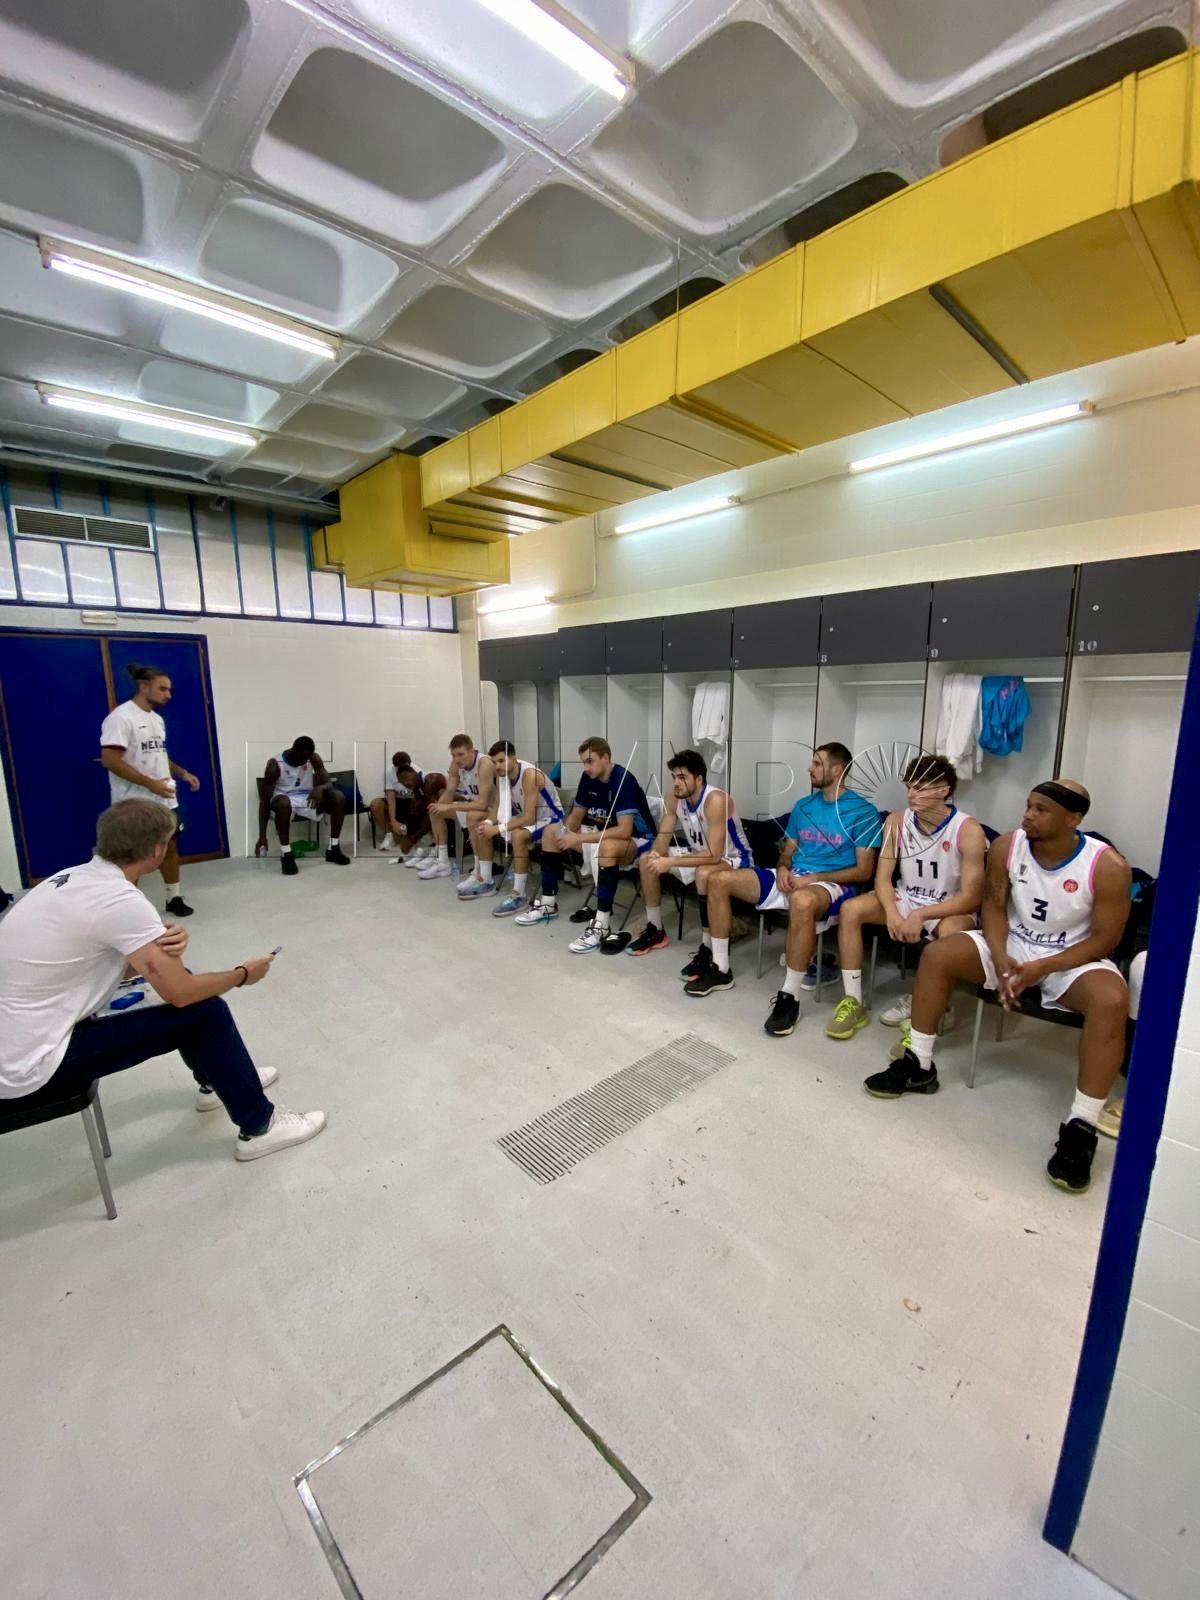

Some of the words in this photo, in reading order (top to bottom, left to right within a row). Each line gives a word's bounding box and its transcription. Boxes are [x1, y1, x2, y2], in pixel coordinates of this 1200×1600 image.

[930, 648, 939, 658] 9
[1077, 640, 1098, 652] 10
[689, 828, 704, 846] 44
[915, 858, 939, 879] 11
[905, 885, 948, 902] MELILLA
[1031, 897, 1049, 922] 3
